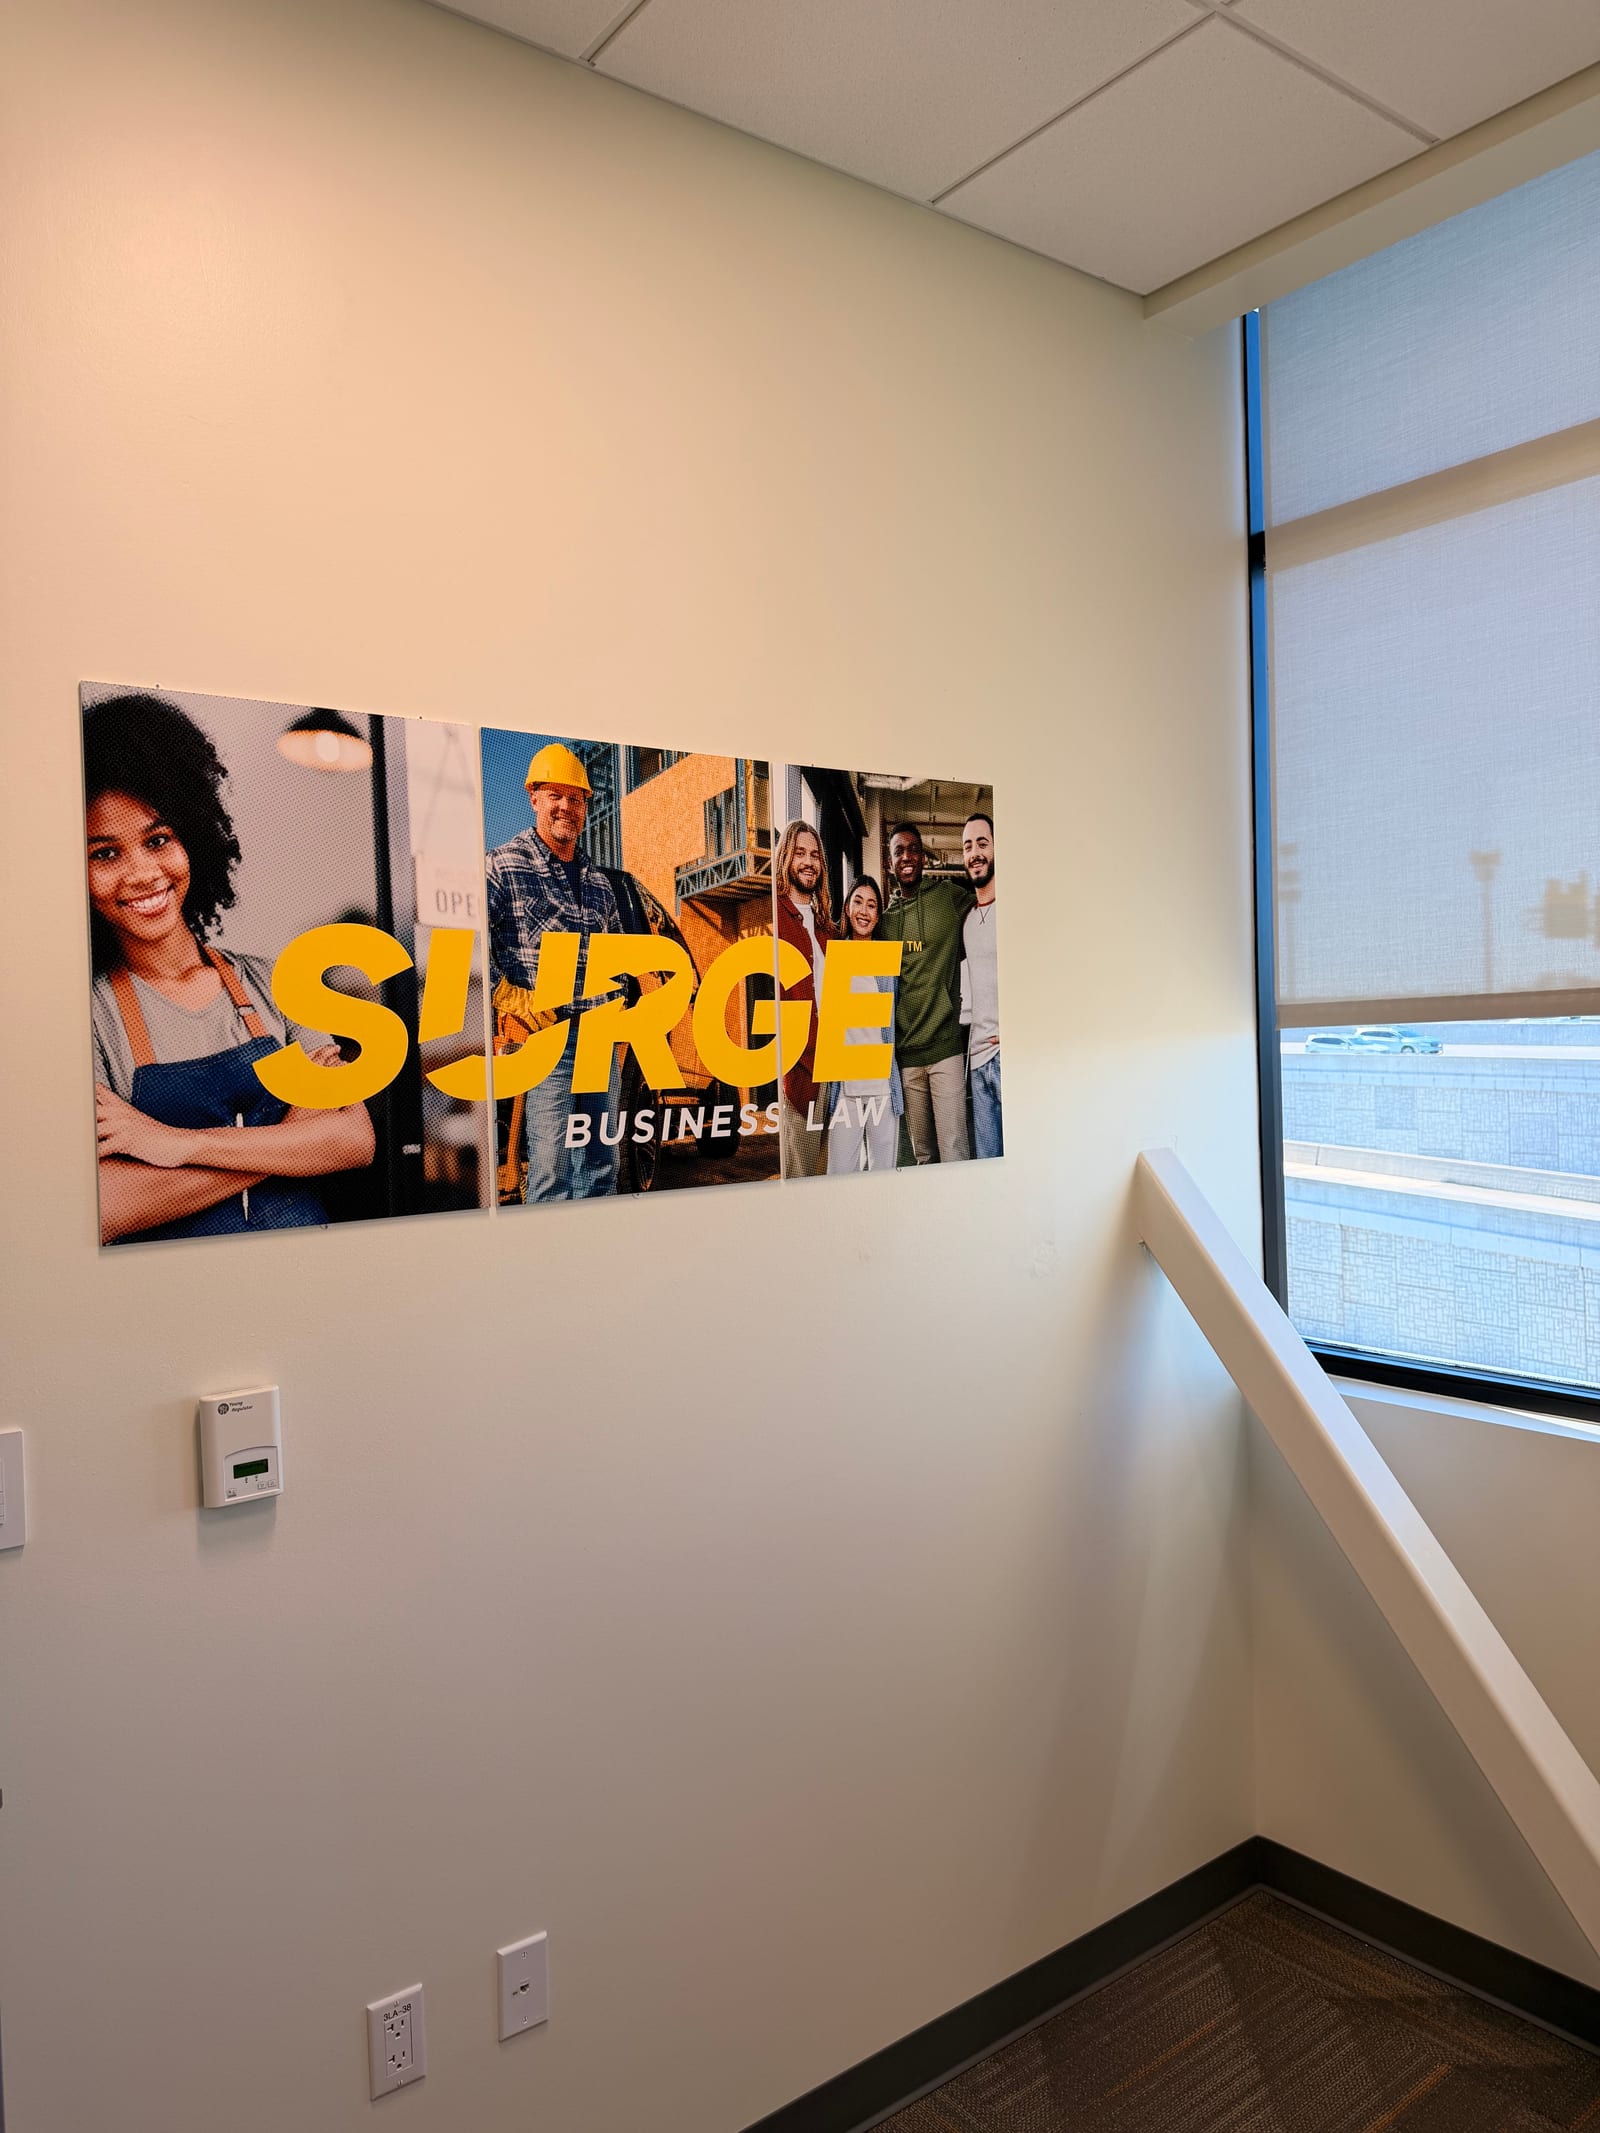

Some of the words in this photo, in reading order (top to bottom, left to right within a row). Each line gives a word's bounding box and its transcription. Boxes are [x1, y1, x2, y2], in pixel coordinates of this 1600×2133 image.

[252, 923, 902, 1109] SURGE
[907, 941, 922, 952] TM
[565, 1102, 787, 1148] BUSINESS
[806, 1096, 887, 1131] LAW
